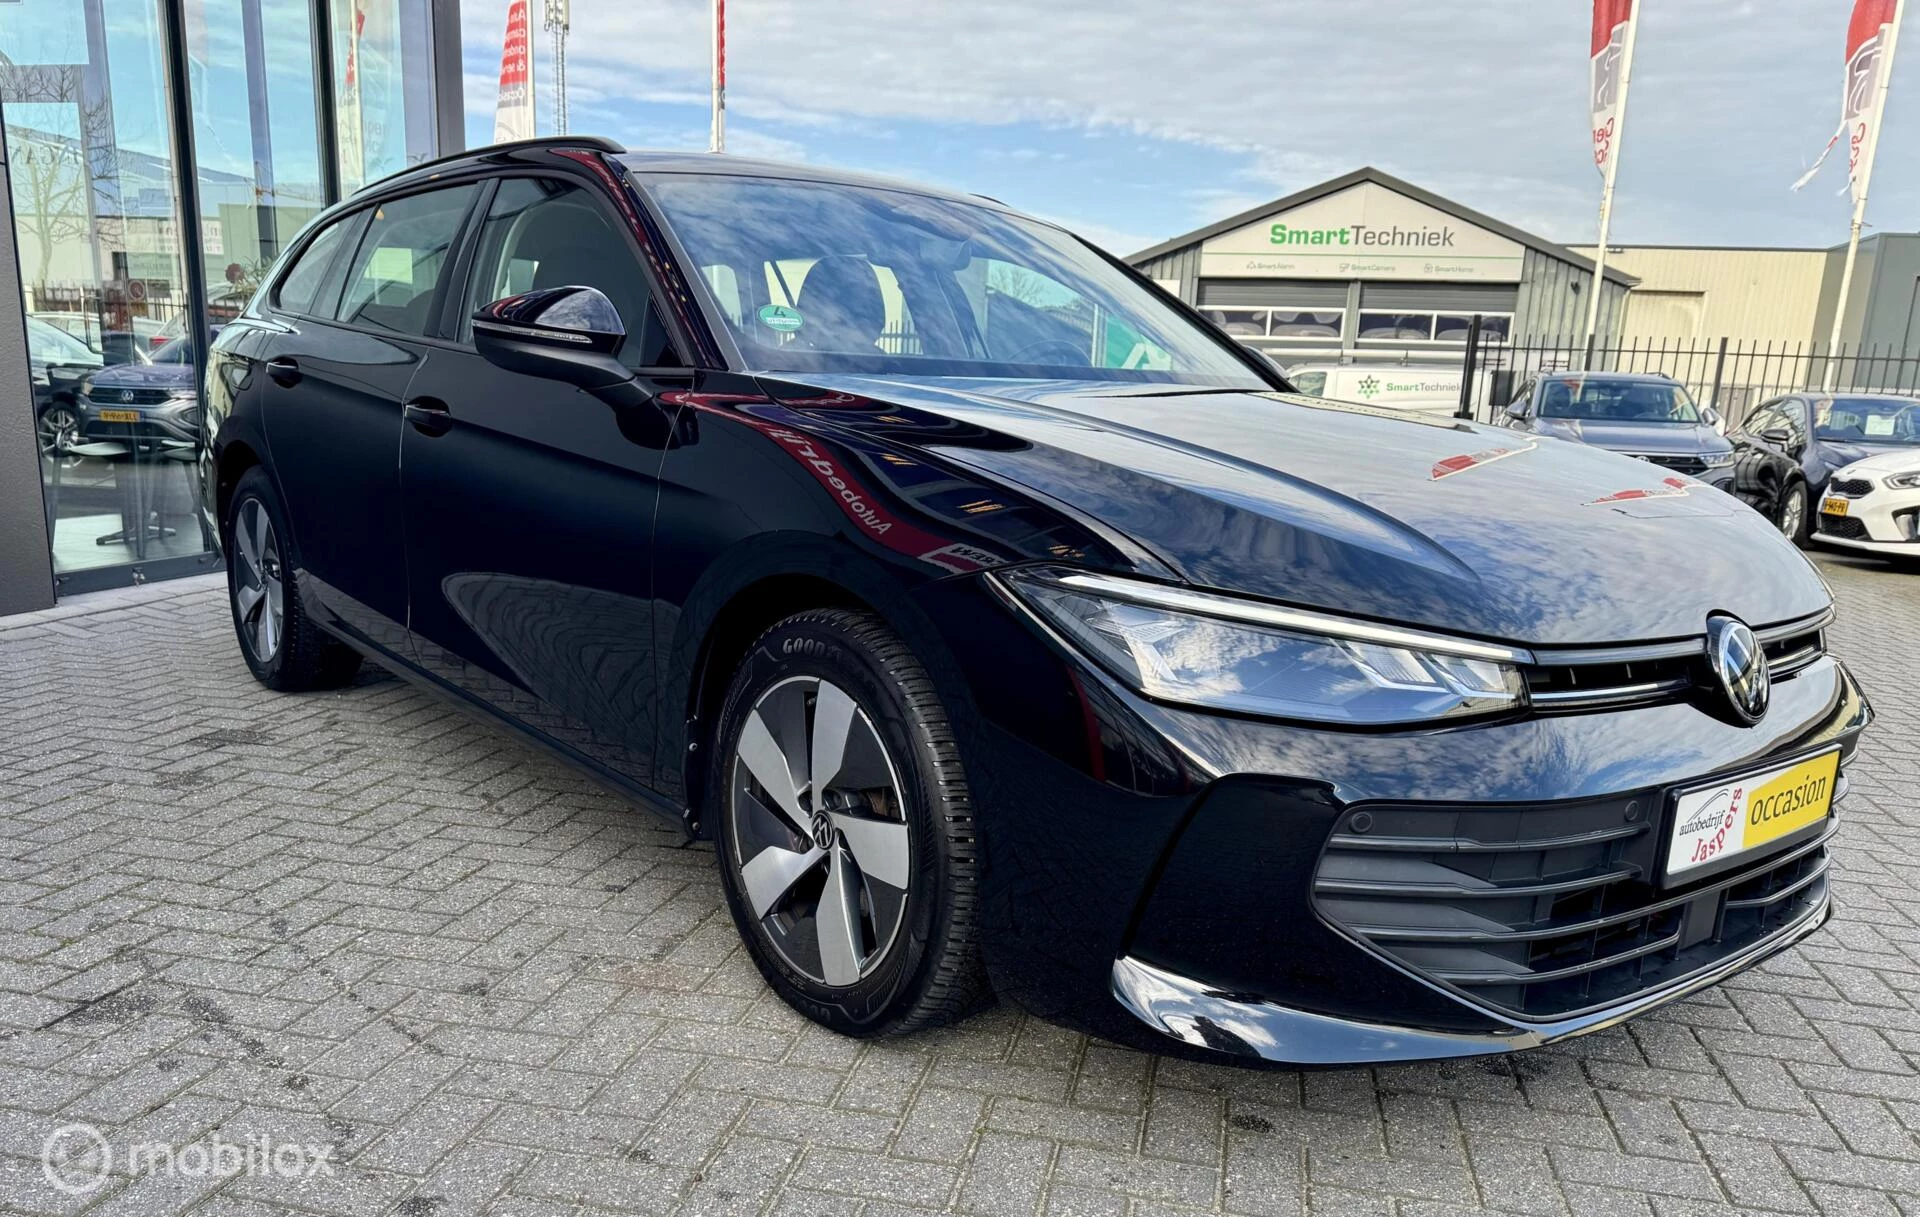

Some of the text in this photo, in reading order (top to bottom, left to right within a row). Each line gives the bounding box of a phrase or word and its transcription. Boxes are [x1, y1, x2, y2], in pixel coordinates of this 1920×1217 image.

[1269, 224, 1455, 247] SmartTechniek
[1750, 774, 1827, 826] occasion
[1679, 809, 1726, 837] autobedrijf
[1691, 786, 1743, 863] Jaspers
